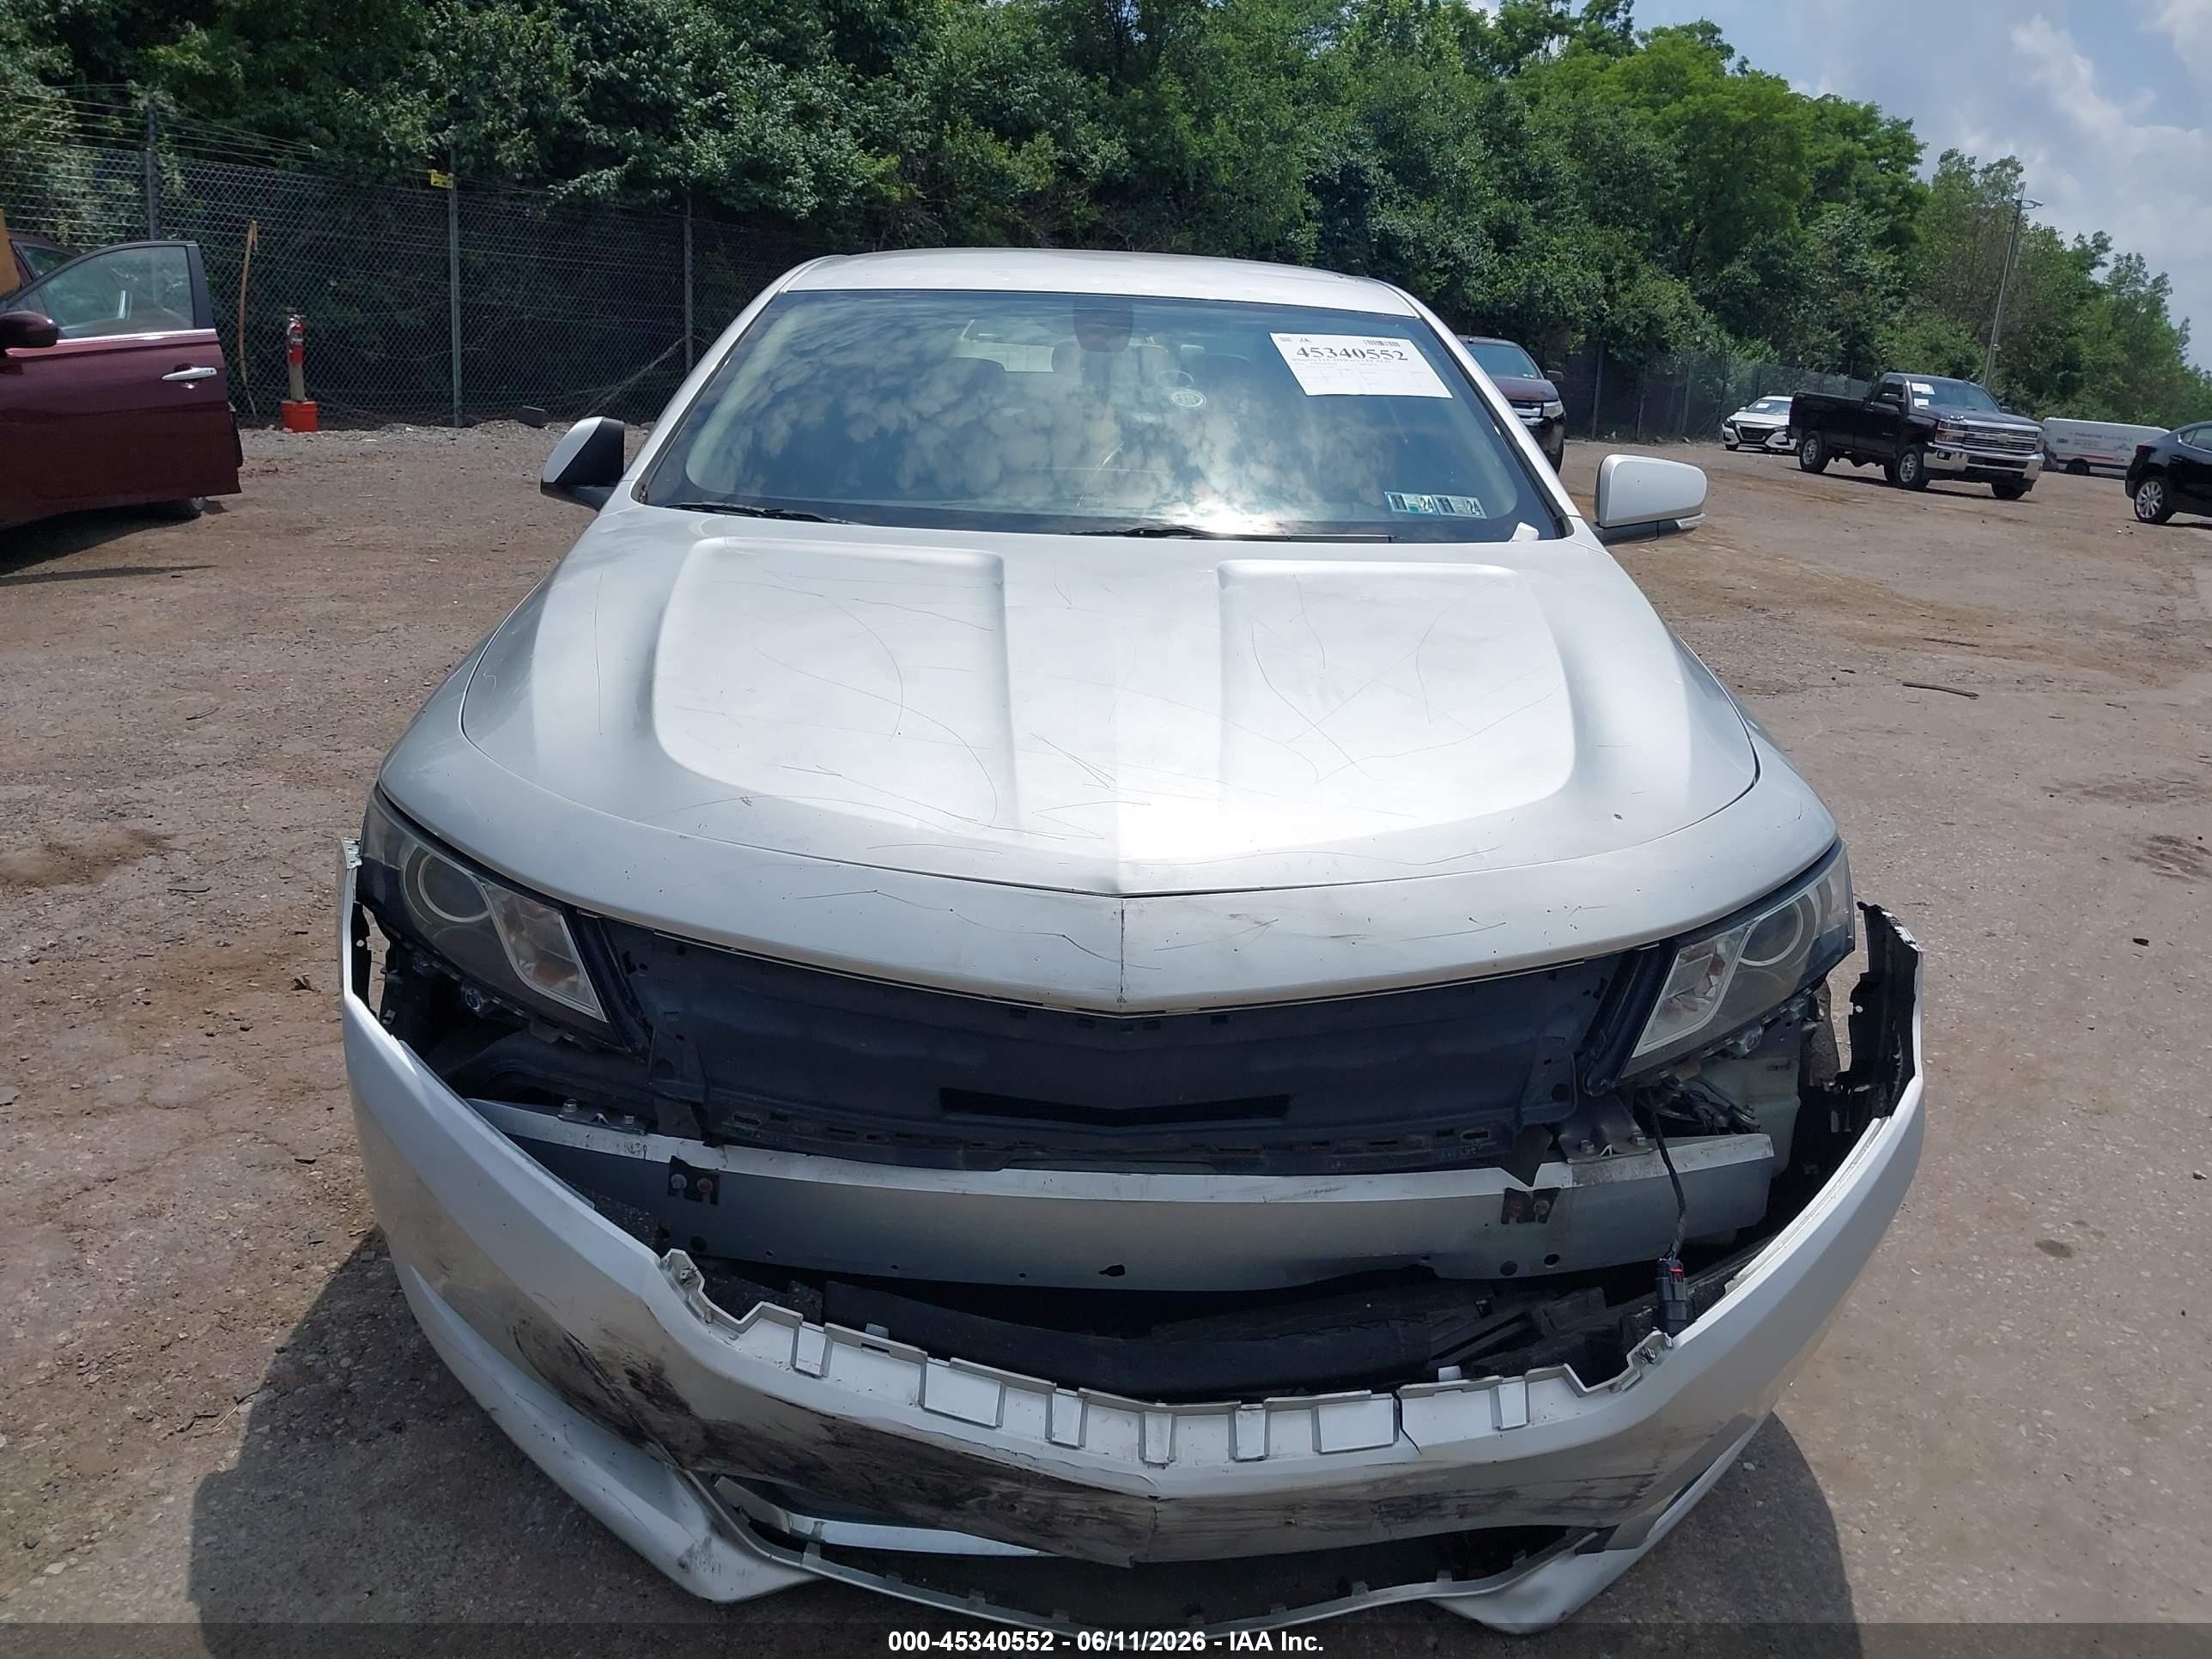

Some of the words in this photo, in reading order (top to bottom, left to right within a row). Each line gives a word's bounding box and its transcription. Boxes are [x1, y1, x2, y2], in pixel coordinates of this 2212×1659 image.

[1296, 346, 1408, 362] 45340552
[1419, 496, 1434, 513] 24
[1465, 500, 1482, 515] 24
